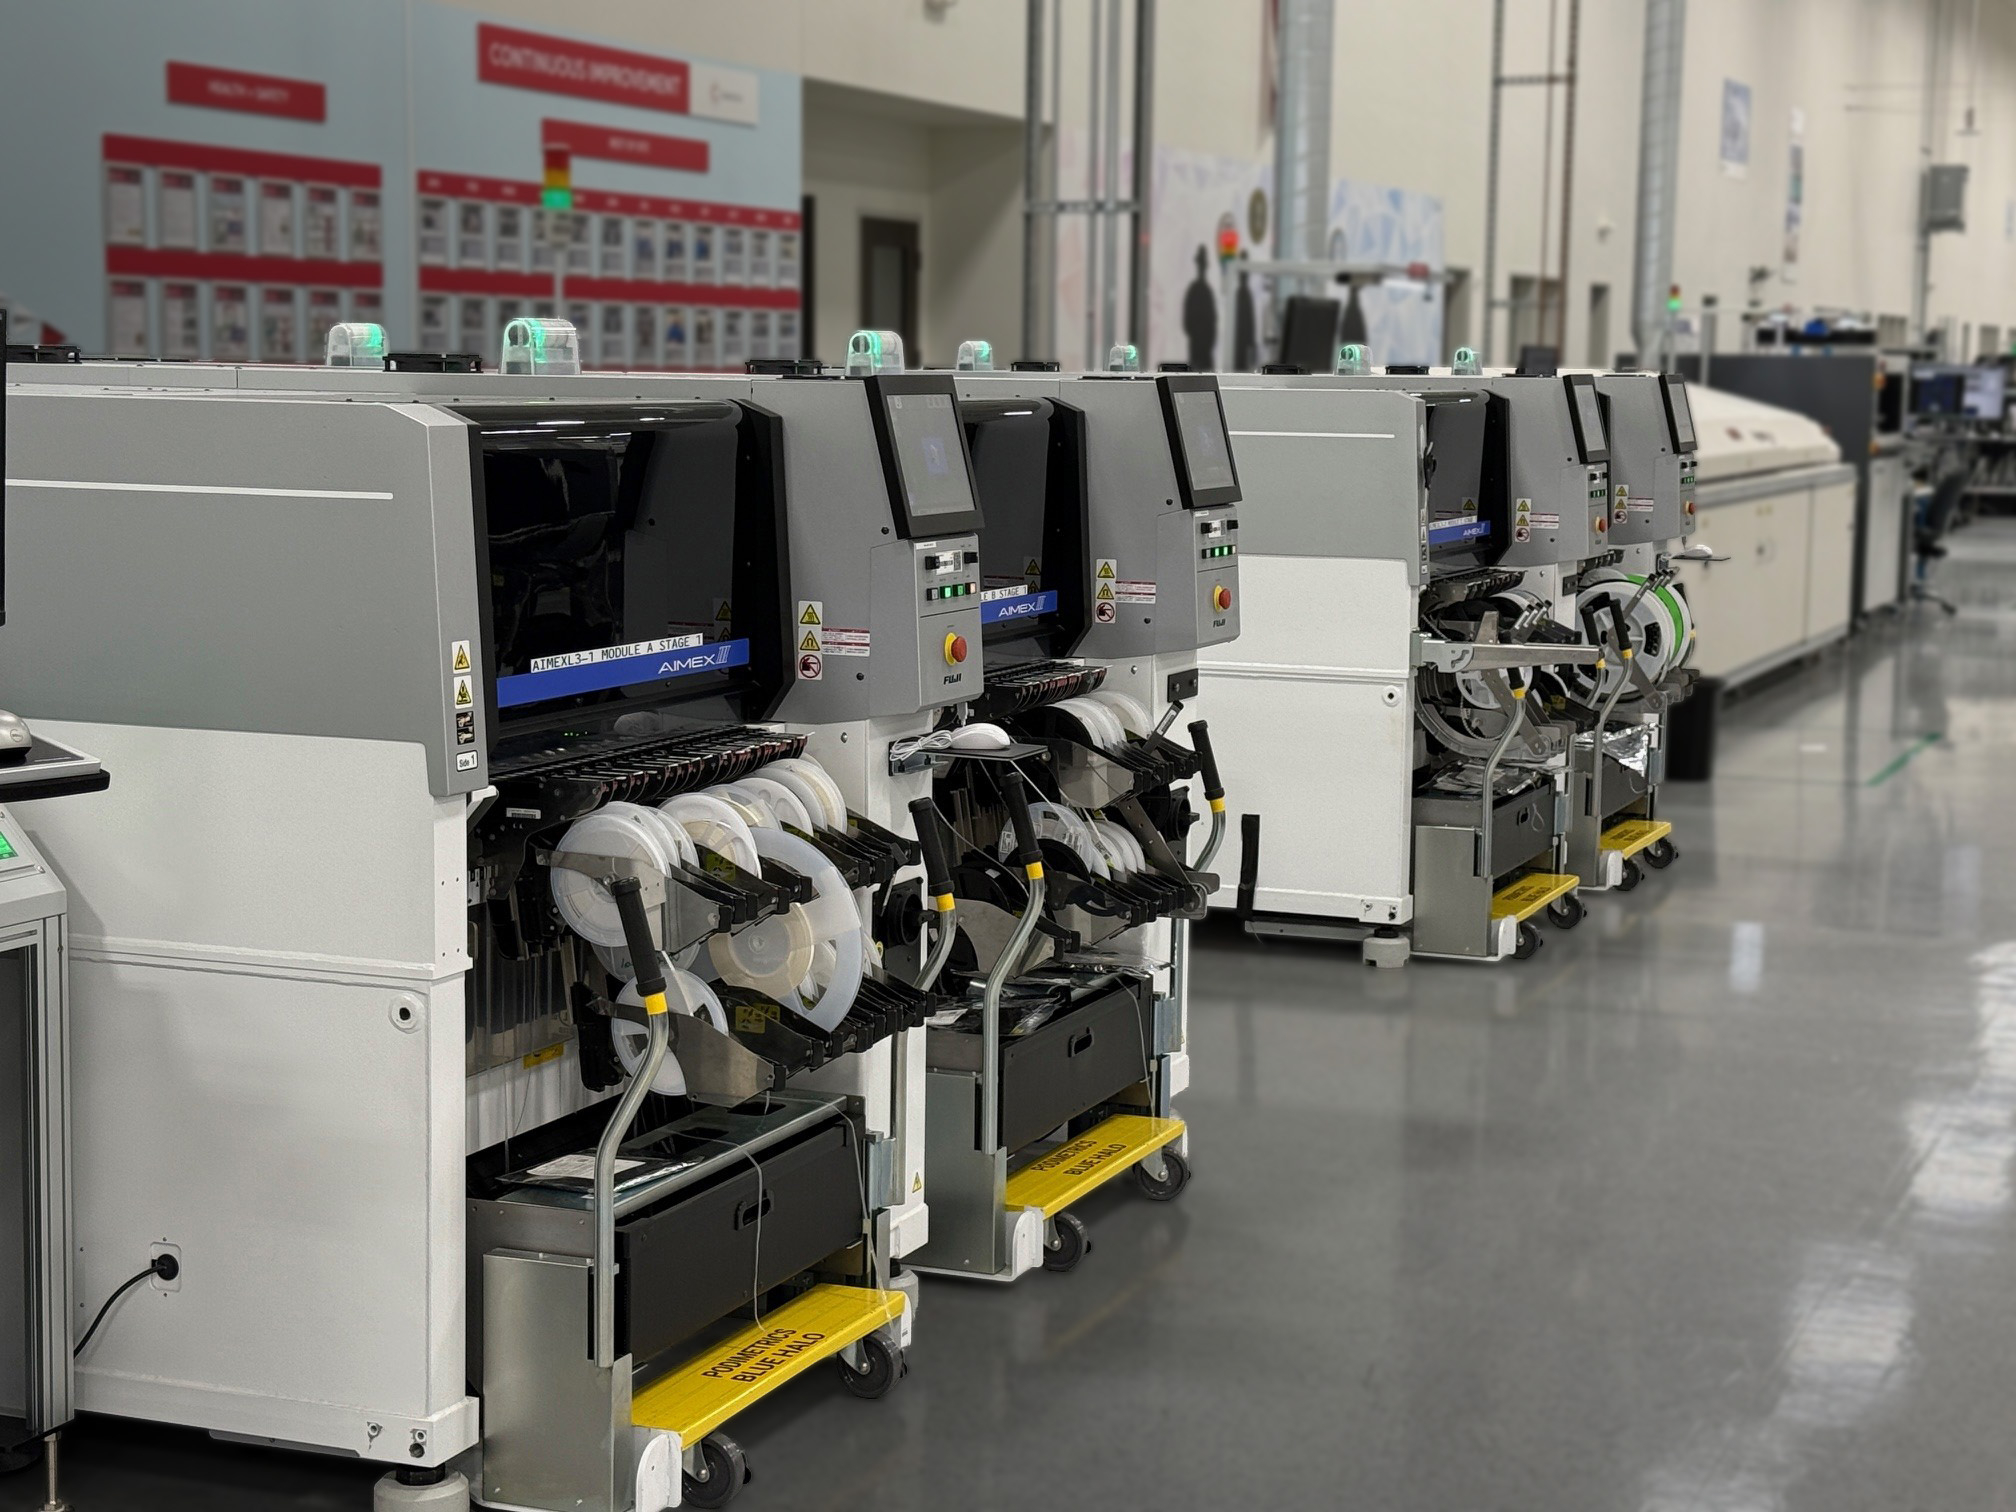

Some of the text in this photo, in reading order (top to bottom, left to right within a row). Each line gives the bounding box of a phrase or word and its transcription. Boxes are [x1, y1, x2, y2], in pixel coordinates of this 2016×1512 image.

[488, 42, 586, 82] CONTINUOUS
[588, 60, 682, 97] IMPROVEMENT
[999, 587, 1019, 598] STAGE
[1213, 618, 1226, 628] FUJI
[532, 635, 701, 672] AIMEXL3-1 MODULE A STAGE 1
[943, 673, 962, 685] FUJI
[459, 754, 475, 768] Side 1
[1063, 1143, 1127, 1176] BLUE HALO
[701, 1328, 797, 1378] PODIMETRICS
[730, 1333, 826, 1382] BLUE HALO
